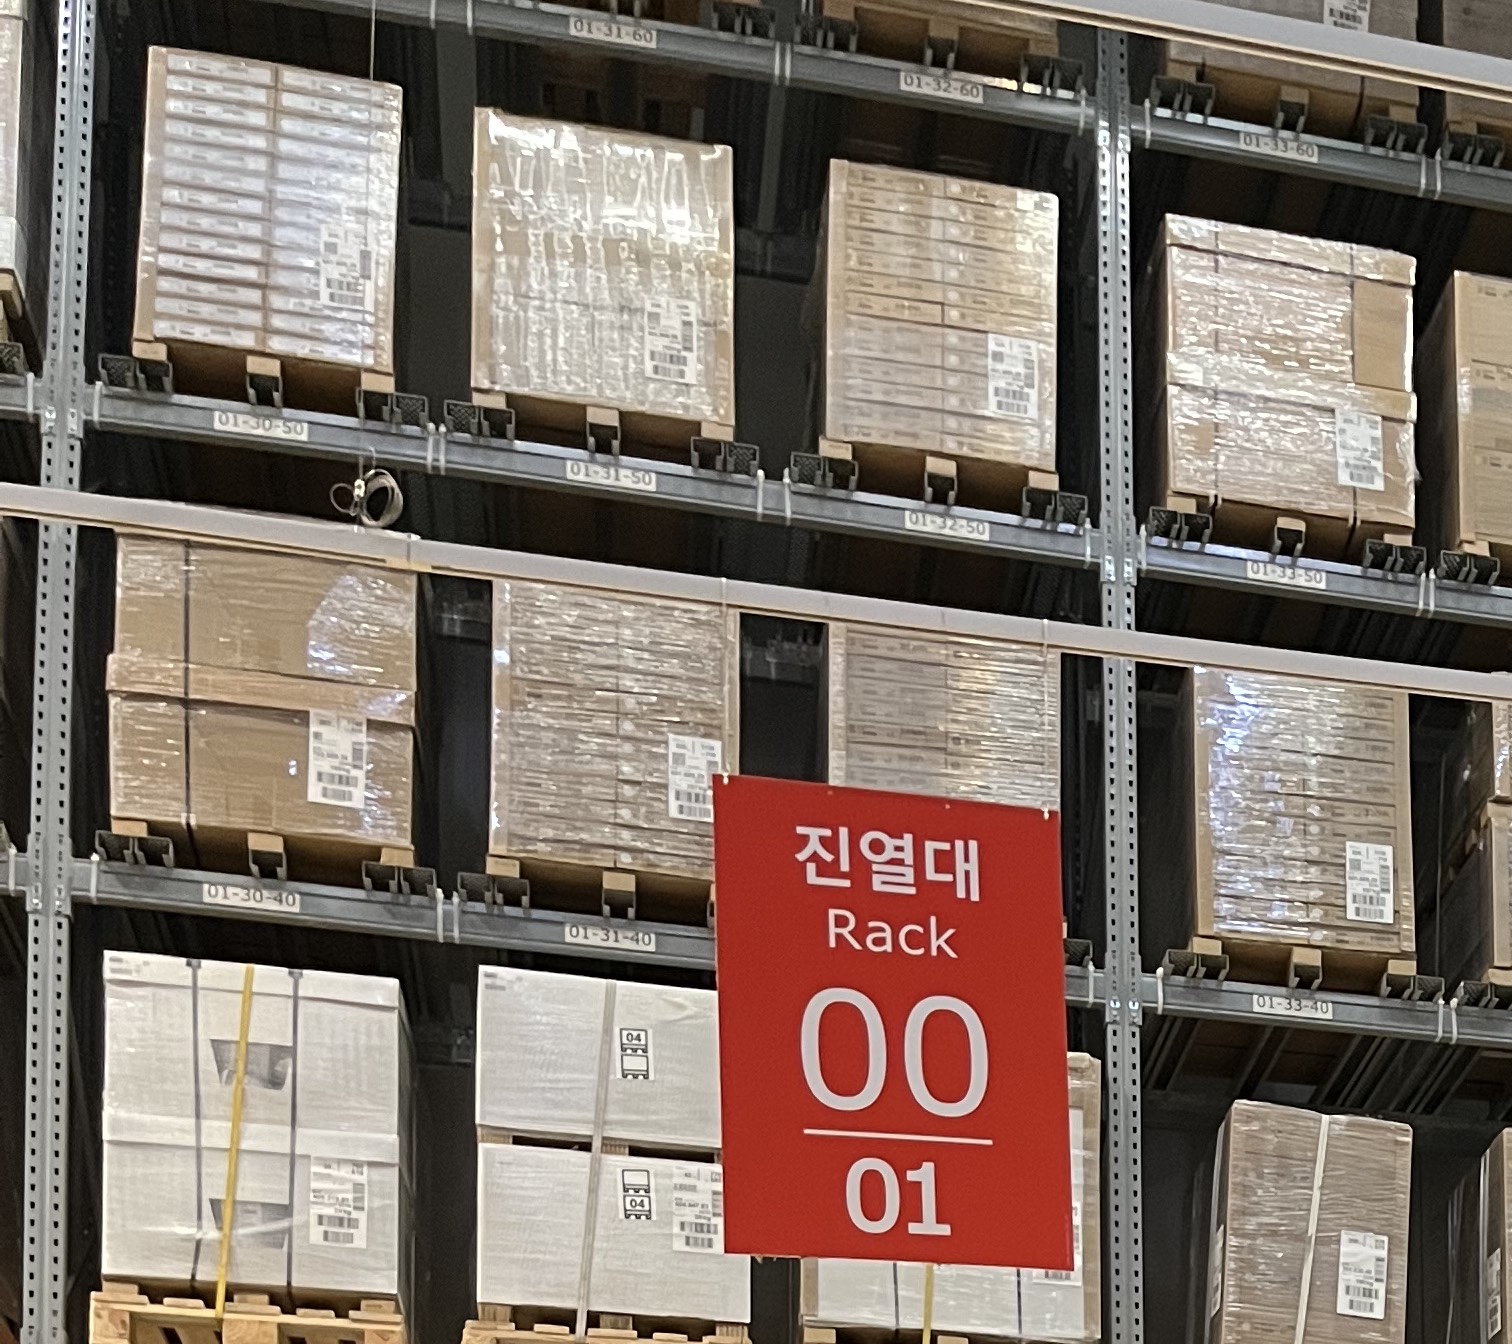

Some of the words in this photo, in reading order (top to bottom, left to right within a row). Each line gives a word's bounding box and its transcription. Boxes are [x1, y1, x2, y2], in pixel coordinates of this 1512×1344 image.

[573, 18, 653, 43] 01-31-60
[904, 72, 979, 99] 01-32-60
[1244, 133, 1315, 158] 01-33-60
[217, 414, 304, 437] 01-30-50
[569, 462, 652, 486] 01-31-50
[908, 513, 986, 536] 01-32-50
[1250, 562, 1322, 583] 01-33-50
[794, 825, 981, 902] 진열대
[207, 886, 296, 907] 01-30-40
[569, 924, 652, 947] 01-31-40
[828, 908, 959, 959] Rack
[1256, 996, 1329, 1015] 01-33-40
[626, 1032, 642, 1043] 04
[801, 986, 989, 1118] 00
[629, 1198, 645, 1209] 04
[845, 1156, 952, 1236] 01
